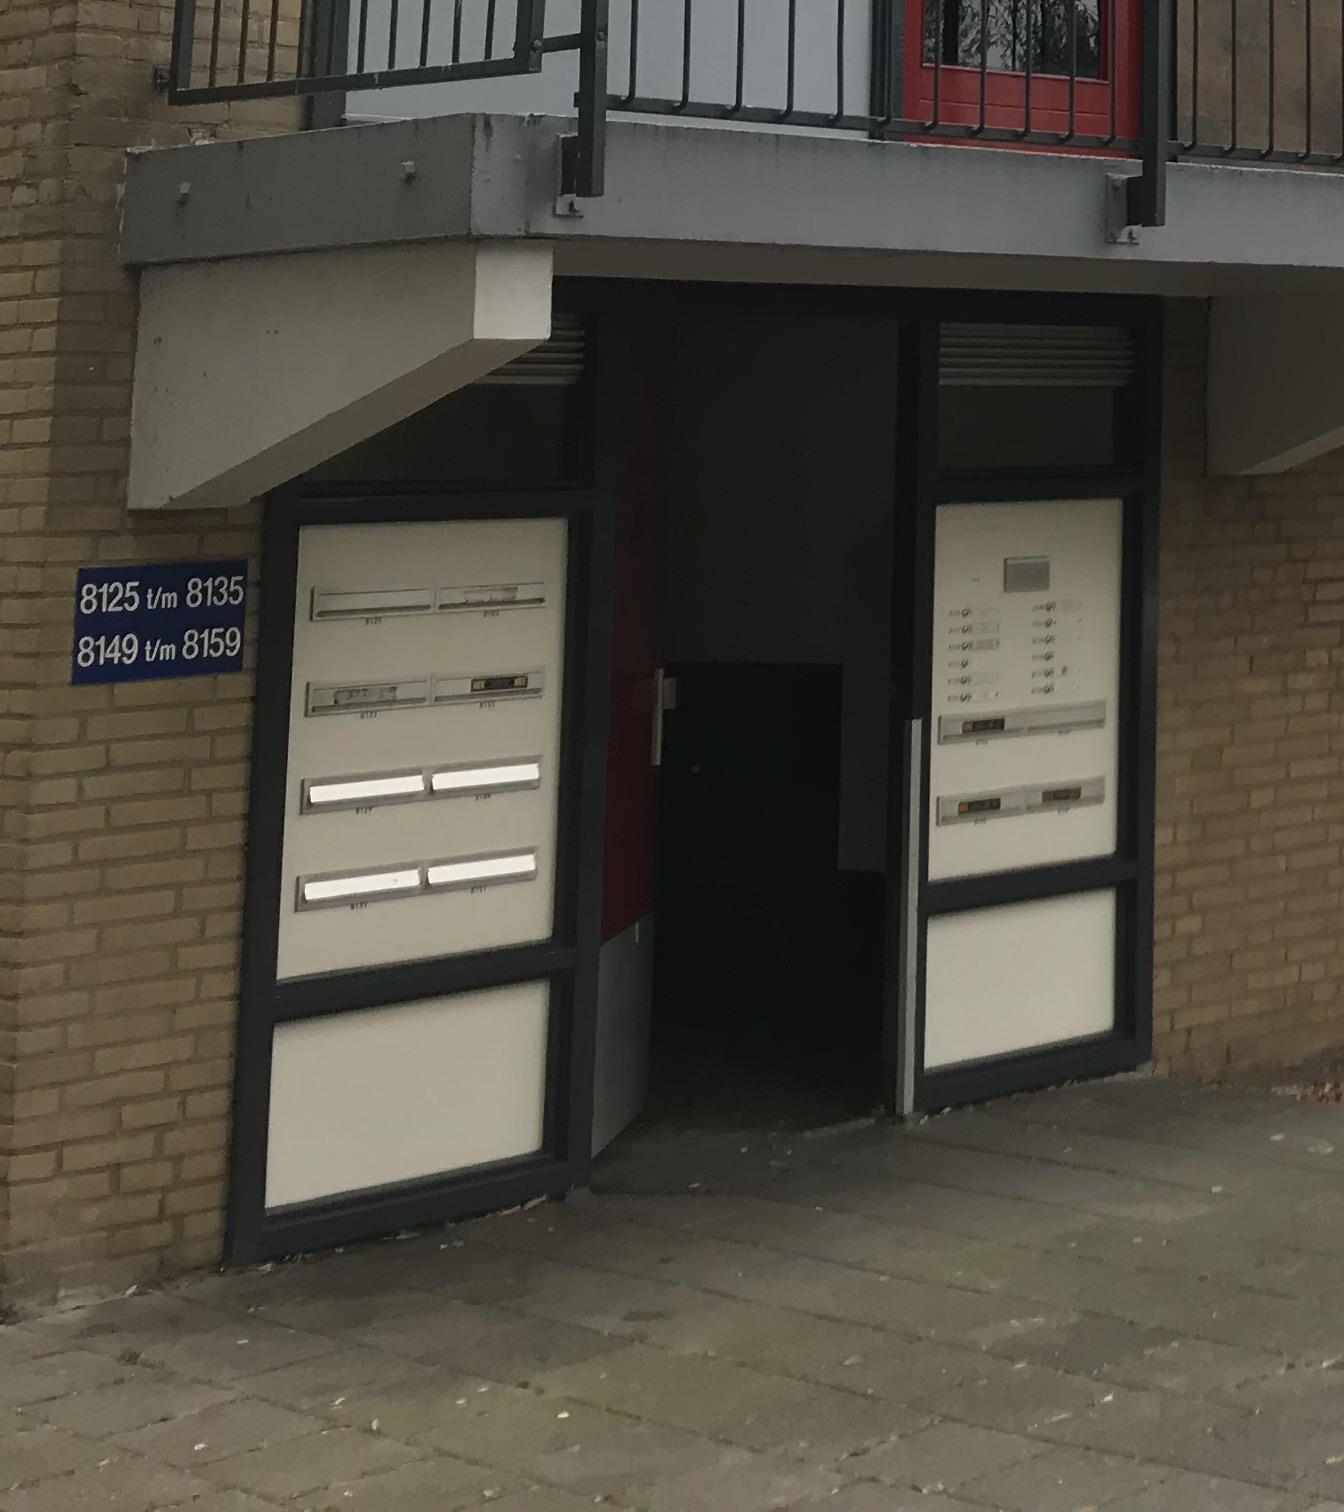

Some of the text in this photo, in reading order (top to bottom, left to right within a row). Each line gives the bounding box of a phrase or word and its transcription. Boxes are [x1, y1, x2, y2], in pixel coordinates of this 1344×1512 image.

[80, 575, 244, 614] 8125 t/m 8135
[76, 626, 241, 668] 8149 t/m 8159
